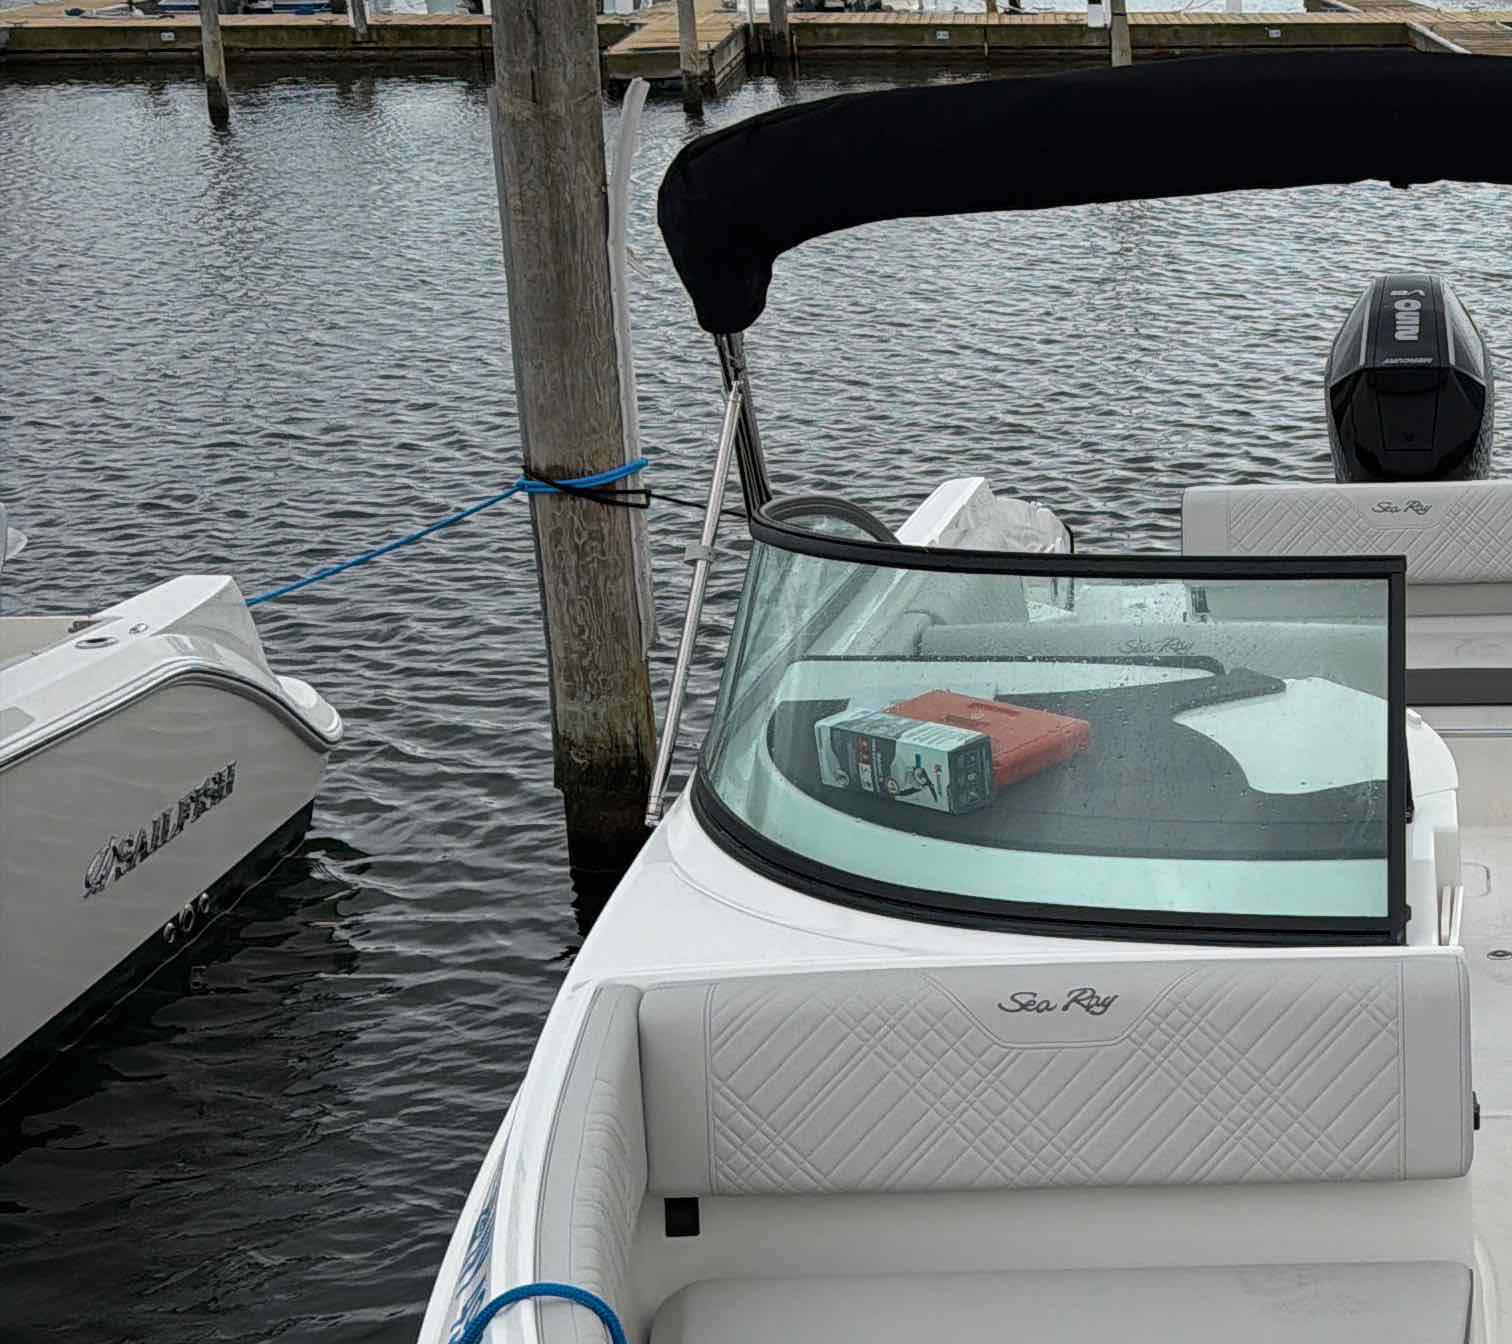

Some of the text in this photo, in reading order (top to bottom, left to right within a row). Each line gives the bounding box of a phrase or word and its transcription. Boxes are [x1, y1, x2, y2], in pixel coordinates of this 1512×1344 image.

[1371, 500, 1433, 516] Sea Ray
[997, 987, 1120, 1016] Sea Ray
